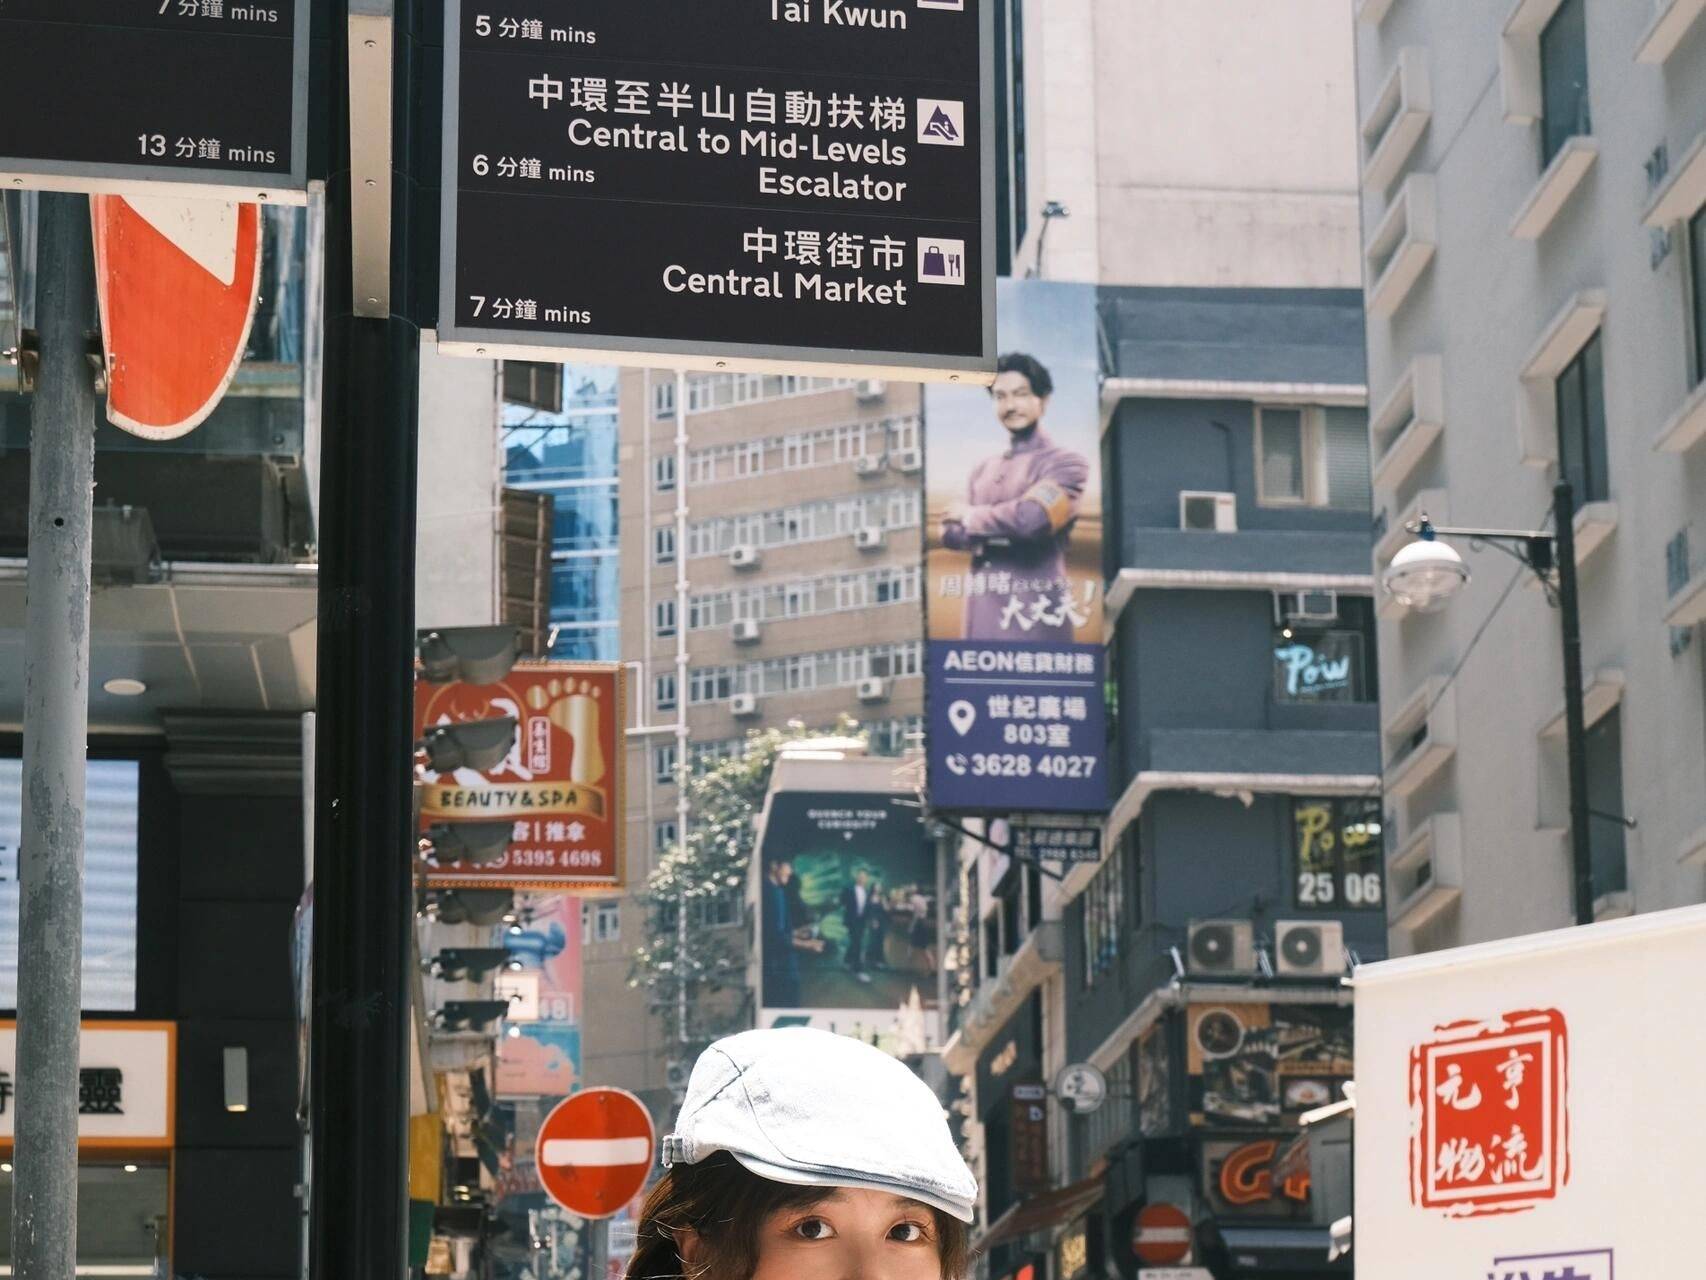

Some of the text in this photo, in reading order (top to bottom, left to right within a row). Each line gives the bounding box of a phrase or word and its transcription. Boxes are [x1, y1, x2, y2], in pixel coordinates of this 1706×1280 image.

[231, 4, 279, 23] mins
[771, 0, 907, 30] Tai Kwun
[474, 15, 597, 45] 5 分鐘 mins
[527, 73, 907, 134] 中環至半山自動扶梯
[137, 133, 277, 164] 13 分鐘 mins
[567, 117, 907, 168] Central to Mid-Levels
[471, 155, 596, 184] 6 分鐘 mins
[758, 168, 907, 202] Escalator
[743, 227, 906, 272] 中環街市
[662, 264, 907, 306] Central Market
[469, 295, 592, 325] 7 分鐘 mins
[987, 694, 1087, 721] 世紀廣場
[1003, 723, 1071, 748] 803室
[971, 753, 1097, 778] 3628 4027
[1299, 872, 1381, 903] 25 06
[1434, 1124, 1544, 1185] 物流
